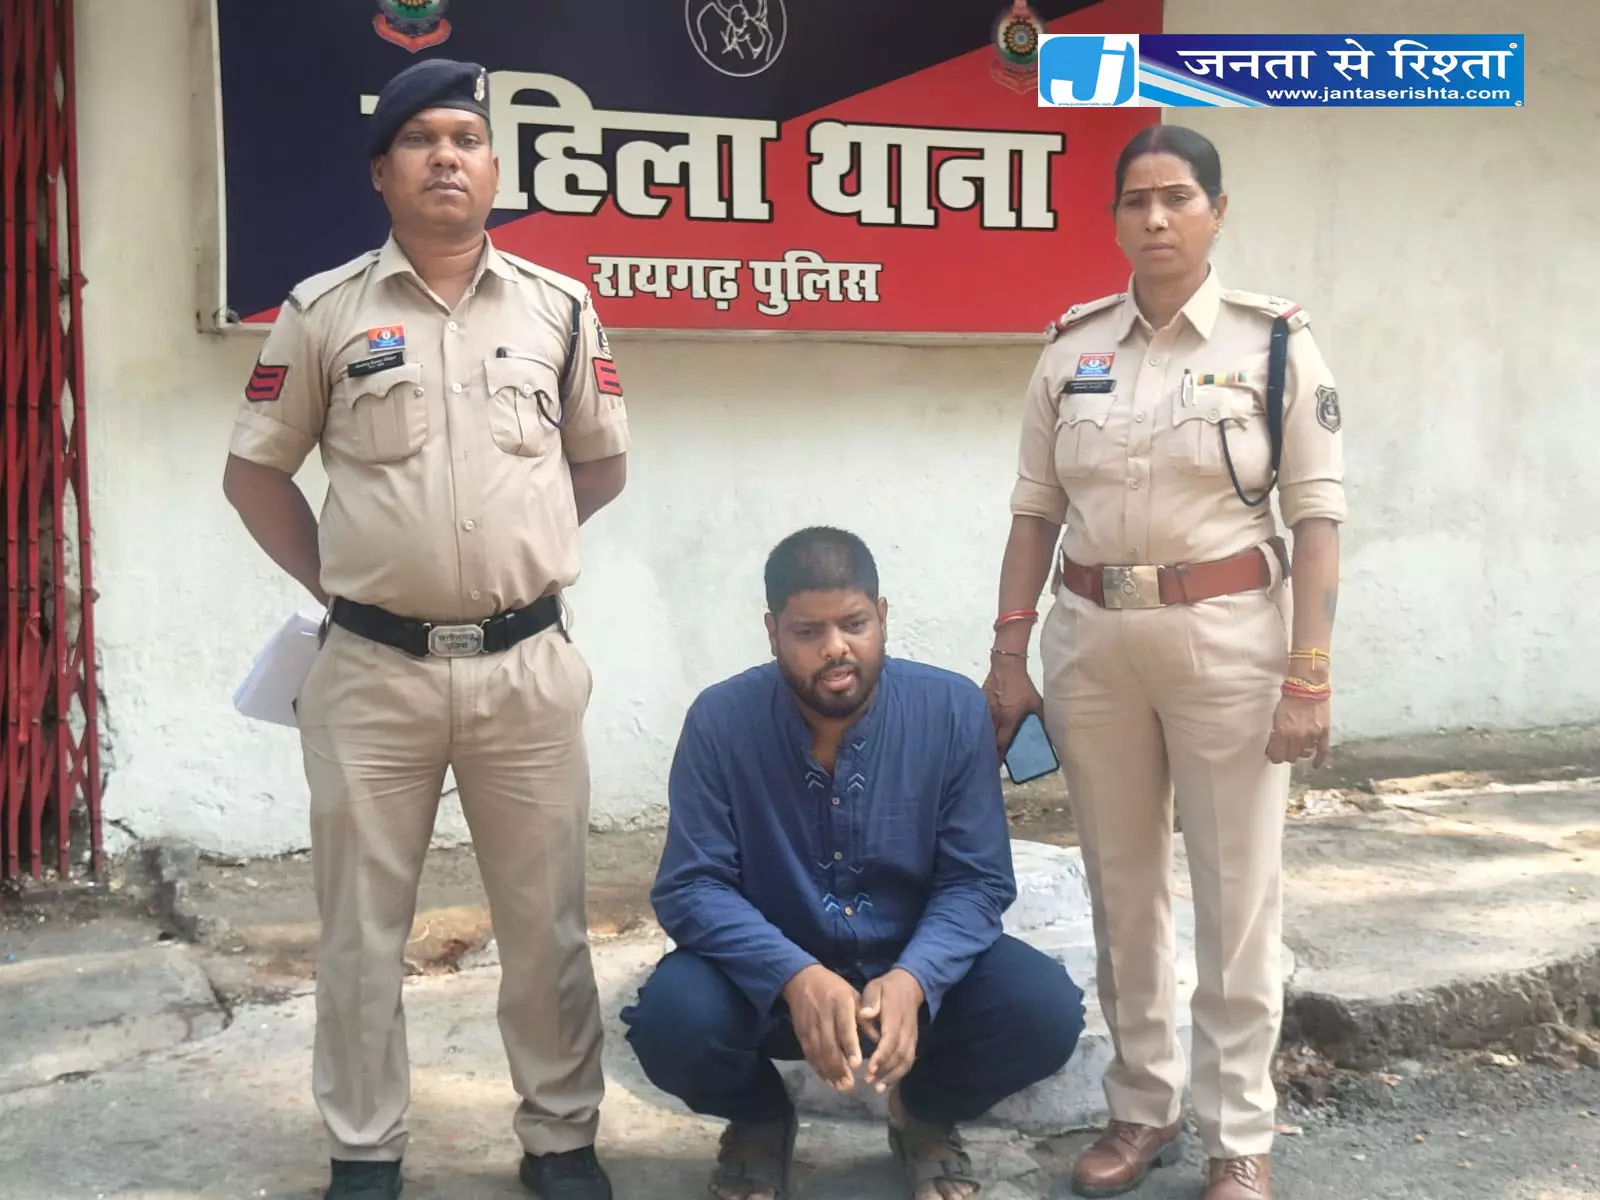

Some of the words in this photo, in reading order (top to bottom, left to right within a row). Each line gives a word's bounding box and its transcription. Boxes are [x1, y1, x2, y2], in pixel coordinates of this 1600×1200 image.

[360, 70, 779, 221] हिला
[807, 118, 1066, 230] थाना
[587, 256, 743, 311] रायगढ़
[748, 249, 883, 316] पुलिस
